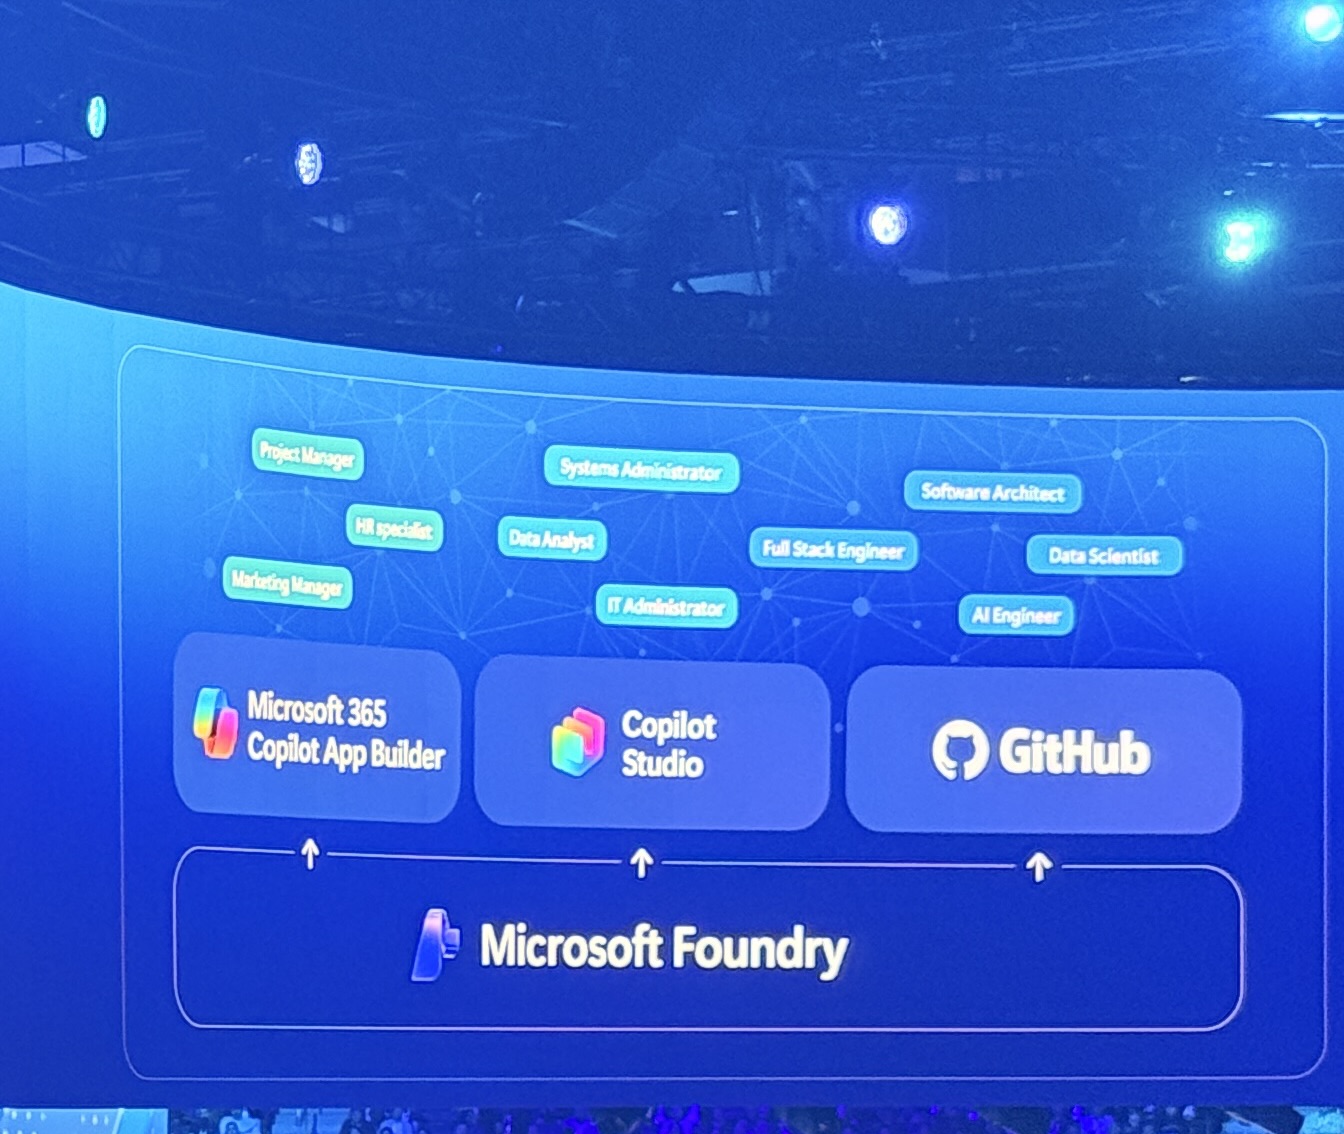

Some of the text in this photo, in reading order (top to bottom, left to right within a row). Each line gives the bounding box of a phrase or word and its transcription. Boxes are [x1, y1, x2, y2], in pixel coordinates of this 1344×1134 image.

[259, 440, 355, 472] Project Manager
[560, 457, 724, 482] Systems Administrator
[921, 482, 1065, 503] Software Architect
[355, 517, 433, 540] HR specialist
[509, 528, 595, 553] Data Analyst
[762, 539, 906, 564] Full Stack Engineer
[1049, 546, 1159, 565] Data Scientist
[231, 569, 343, 601] Marketing Manager
[607, 596, 725, 617] IT Administrator
[971, 606, 1062, 629] AI Engineer
[247, 689, 387, 728] Microsoft 365
[621, 709, 718, 746] Copilot
[247, 731, 447, 774] Copilot App Builder
[622, 749, 704, 778] Studio
[999, 727, 1151, 775] GitHub
[481, 922, 850, 981] Microsoft Foundry
